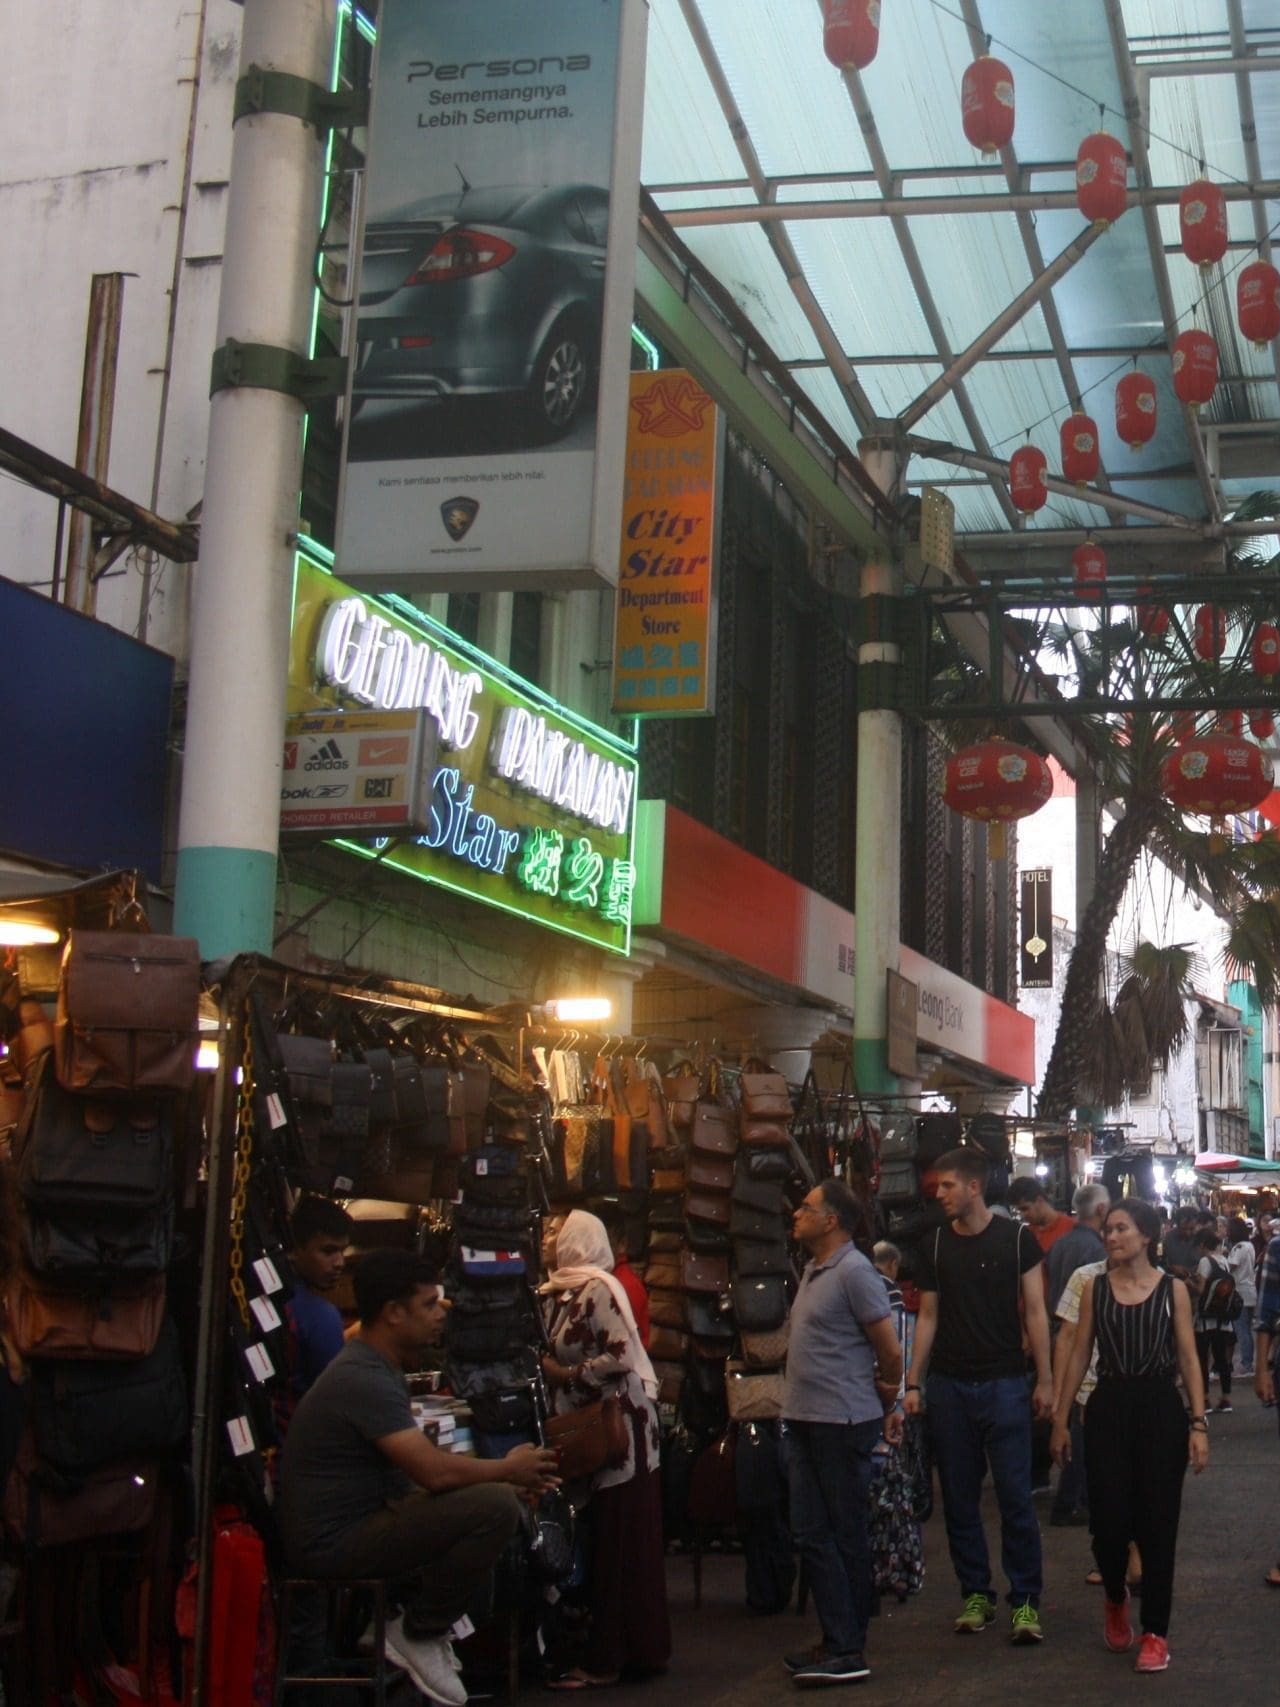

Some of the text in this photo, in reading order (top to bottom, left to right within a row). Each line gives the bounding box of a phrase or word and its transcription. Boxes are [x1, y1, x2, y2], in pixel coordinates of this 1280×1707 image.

[408, 55, 592, 83] Persona
[428, 84, 567, 106] Sememangnya
[417, 105, 574, 128] Lebih Sempurna.
[378, 478, 401, 488] Kami
[502, 471, 523, 481] lebih
[627, 508, 704, 544] City
[620, 549, 708, 579] Star
[620, 588, 704, 611] Department
[641, 616, 681, 635] Store
[303, 759, 349, 772] adidas
[499, 705, 634, 835] PAKAIAN
[330, 808, 378, 822] RETAILER
[417, 768, 520, 874] Star
[1021, 871, 1049, 882] HOTEL
